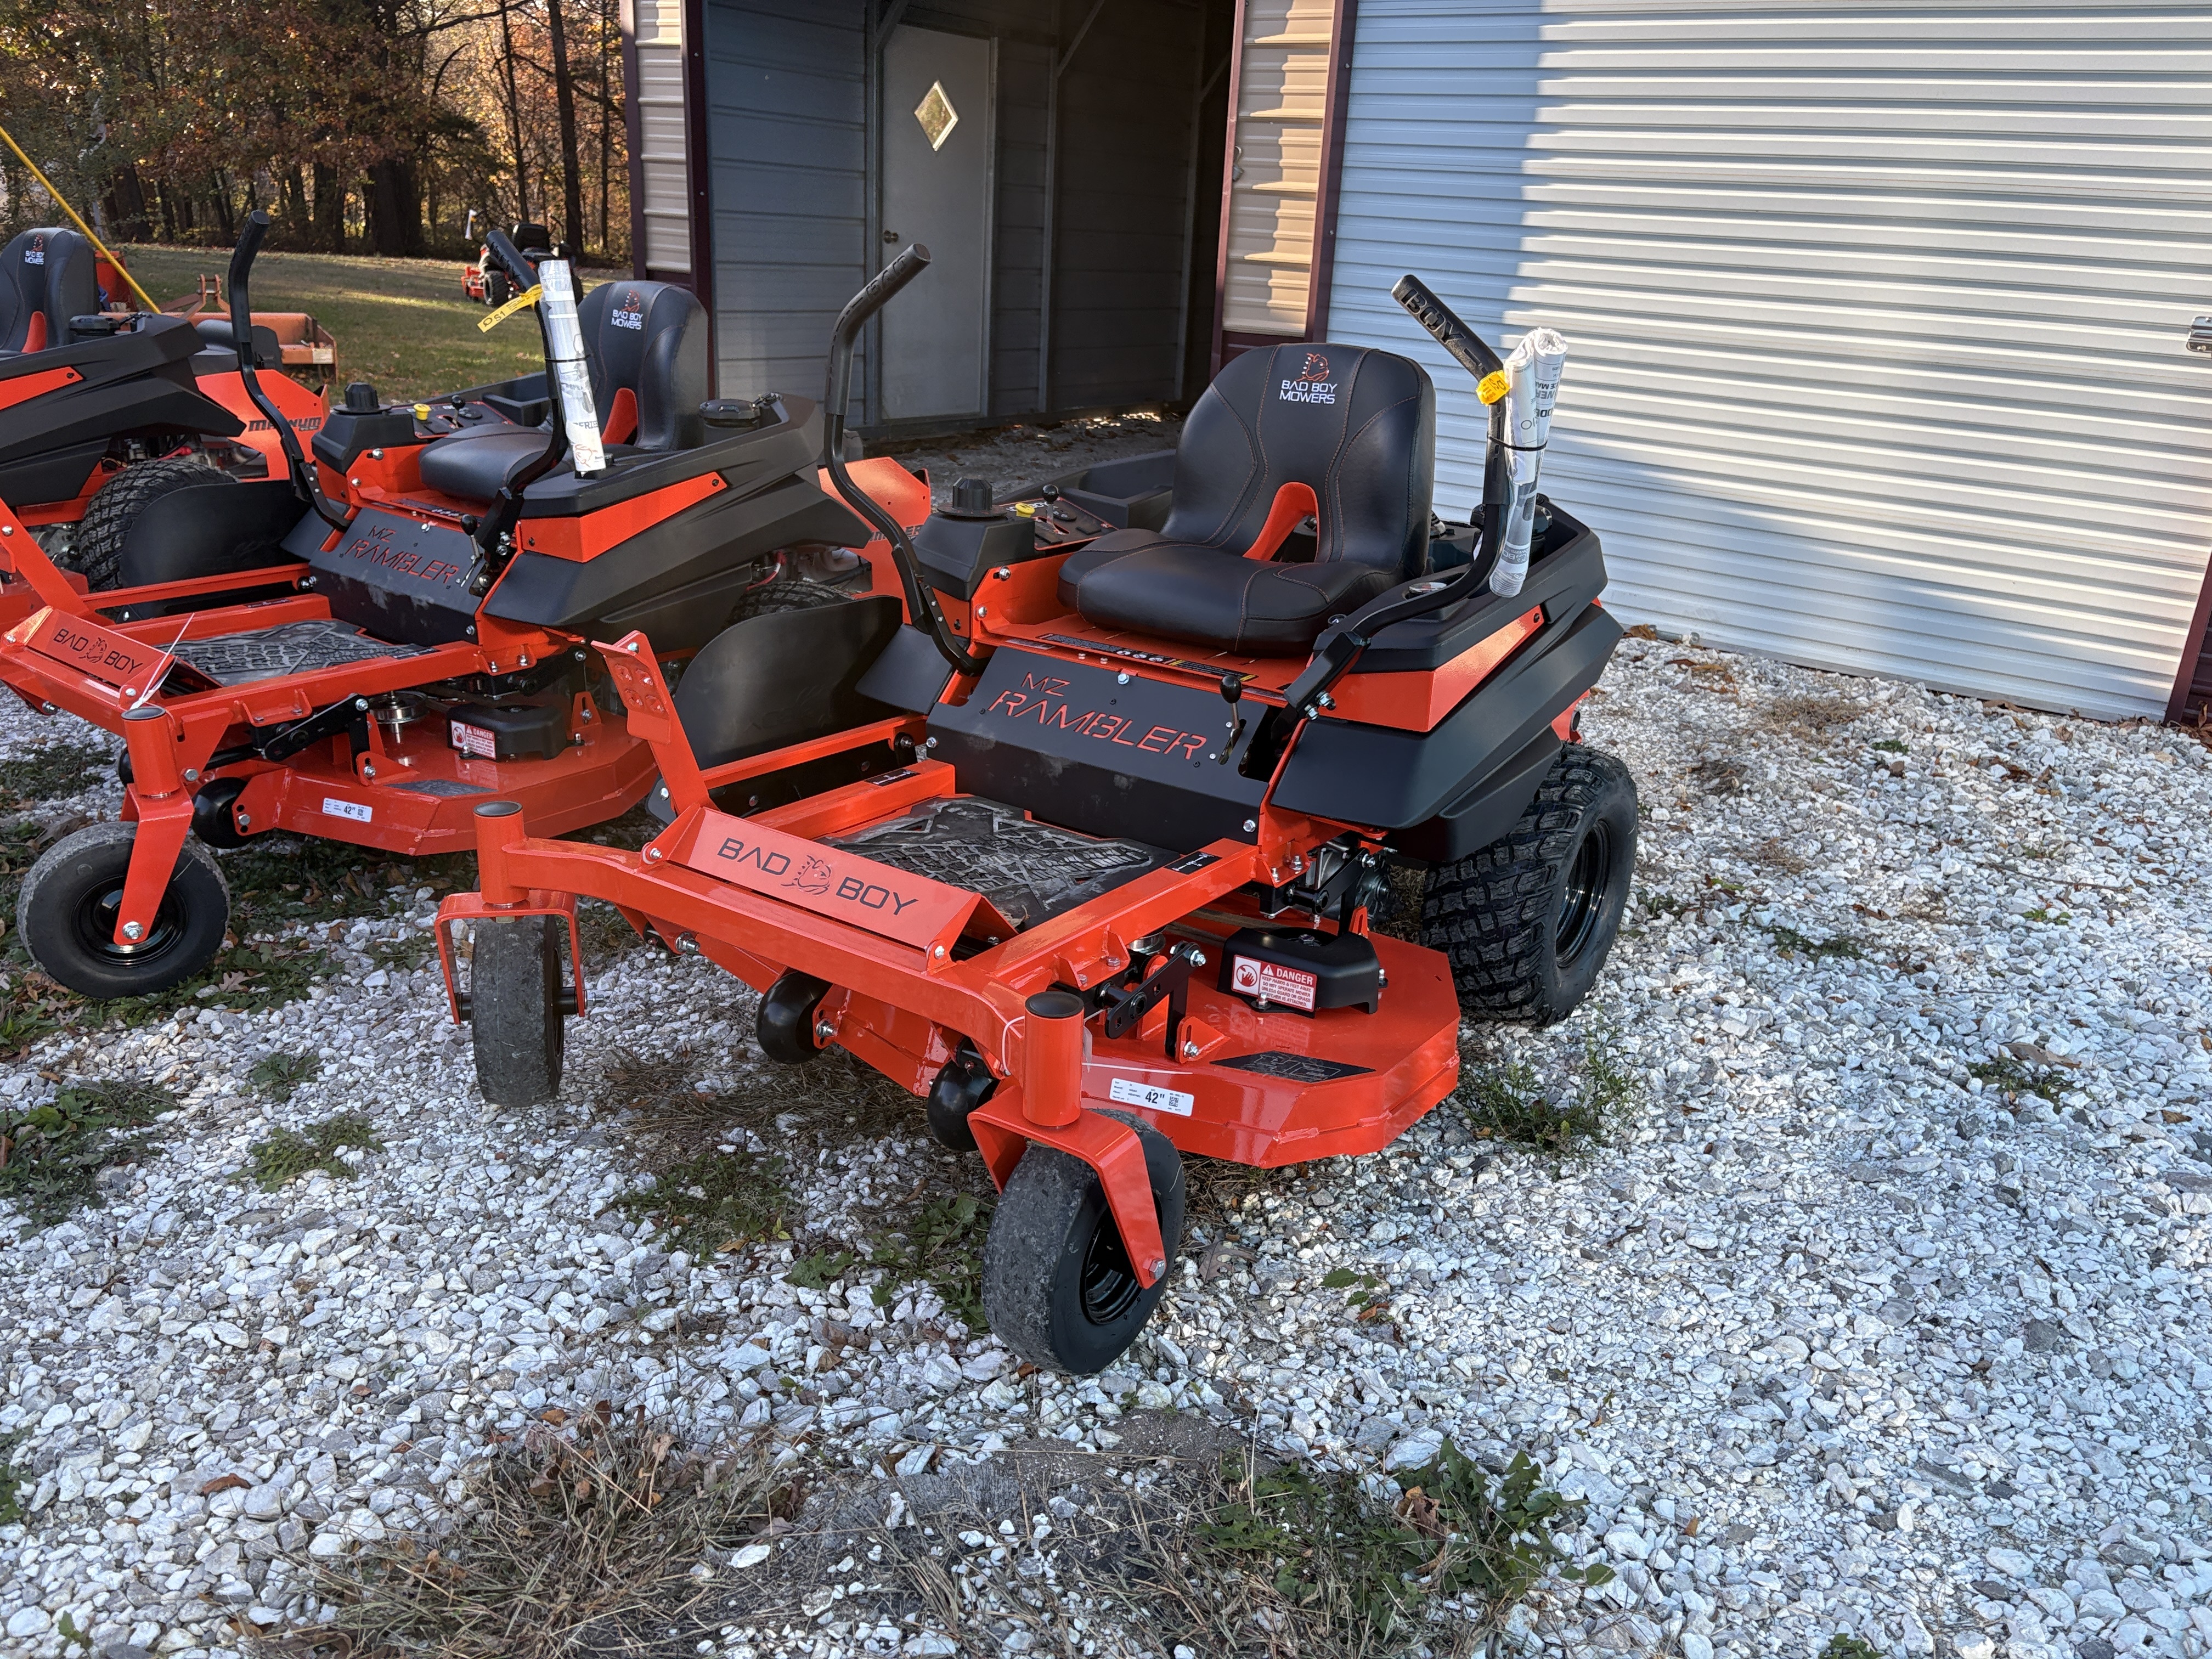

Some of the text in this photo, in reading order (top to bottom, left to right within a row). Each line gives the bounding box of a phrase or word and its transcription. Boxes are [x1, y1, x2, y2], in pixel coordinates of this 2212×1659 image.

[611, 317, 642, 330] MOWERS
[612, 309, 644, 321] BAD BOY
[1401, 289, 1466, 344] BOY
[1282, 380, 1338, 393] BAD BOY
[1279, 390, 1335, 404] MOWERS
[368, 525, 397, 543] MZ
[344, 539, 460, 584] RAMBLER
[53, 628, 143, 674] BAD BOY
[1020, 672, 1070, 697] MZ
[988, 690, 1207, 760] RAMBLER
[473, 728, 493, 740] DANGER
[717, 837, 918, 916] BAD BOY
[1277, 968, 1313, 985] DANGER
[1145, 1091, 1165, 1104] 42"
